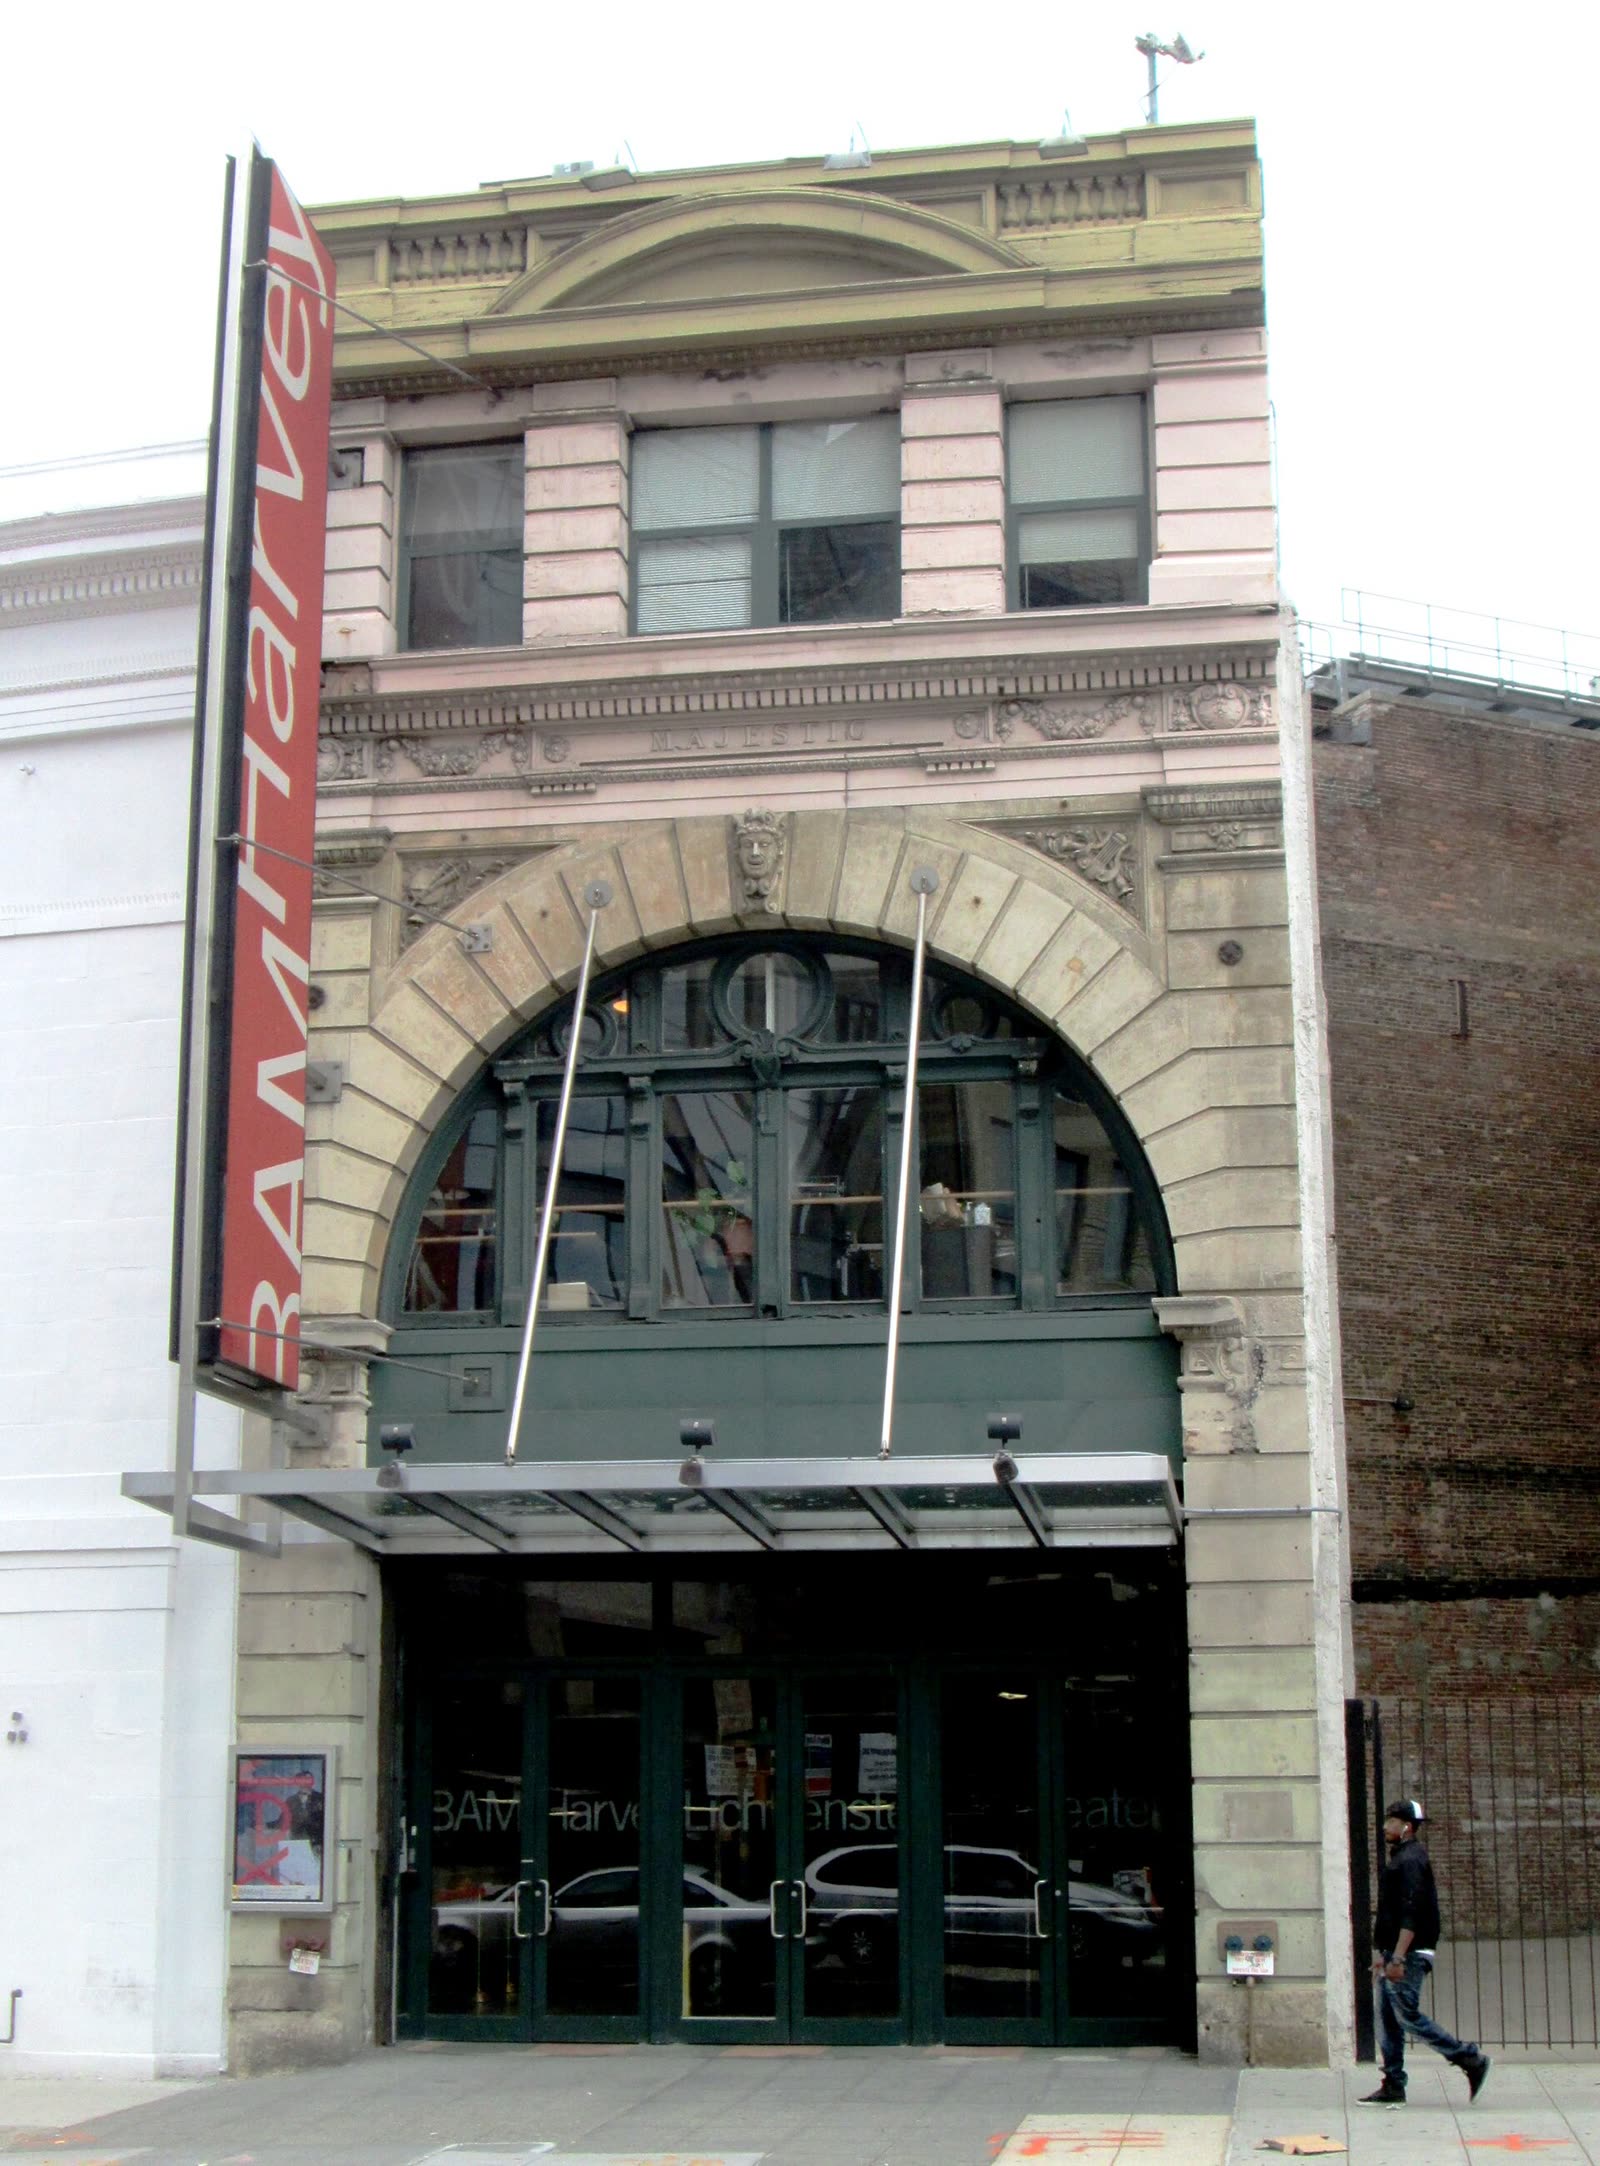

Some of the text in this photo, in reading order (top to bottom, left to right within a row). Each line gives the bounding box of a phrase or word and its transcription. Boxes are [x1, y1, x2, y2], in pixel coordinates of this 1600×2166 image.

[650, 718, 868, 752] MAJESTIC
[238, 168, 328, 1387] BAM Harvey
[432, 1789, 521, 1832] BAM
